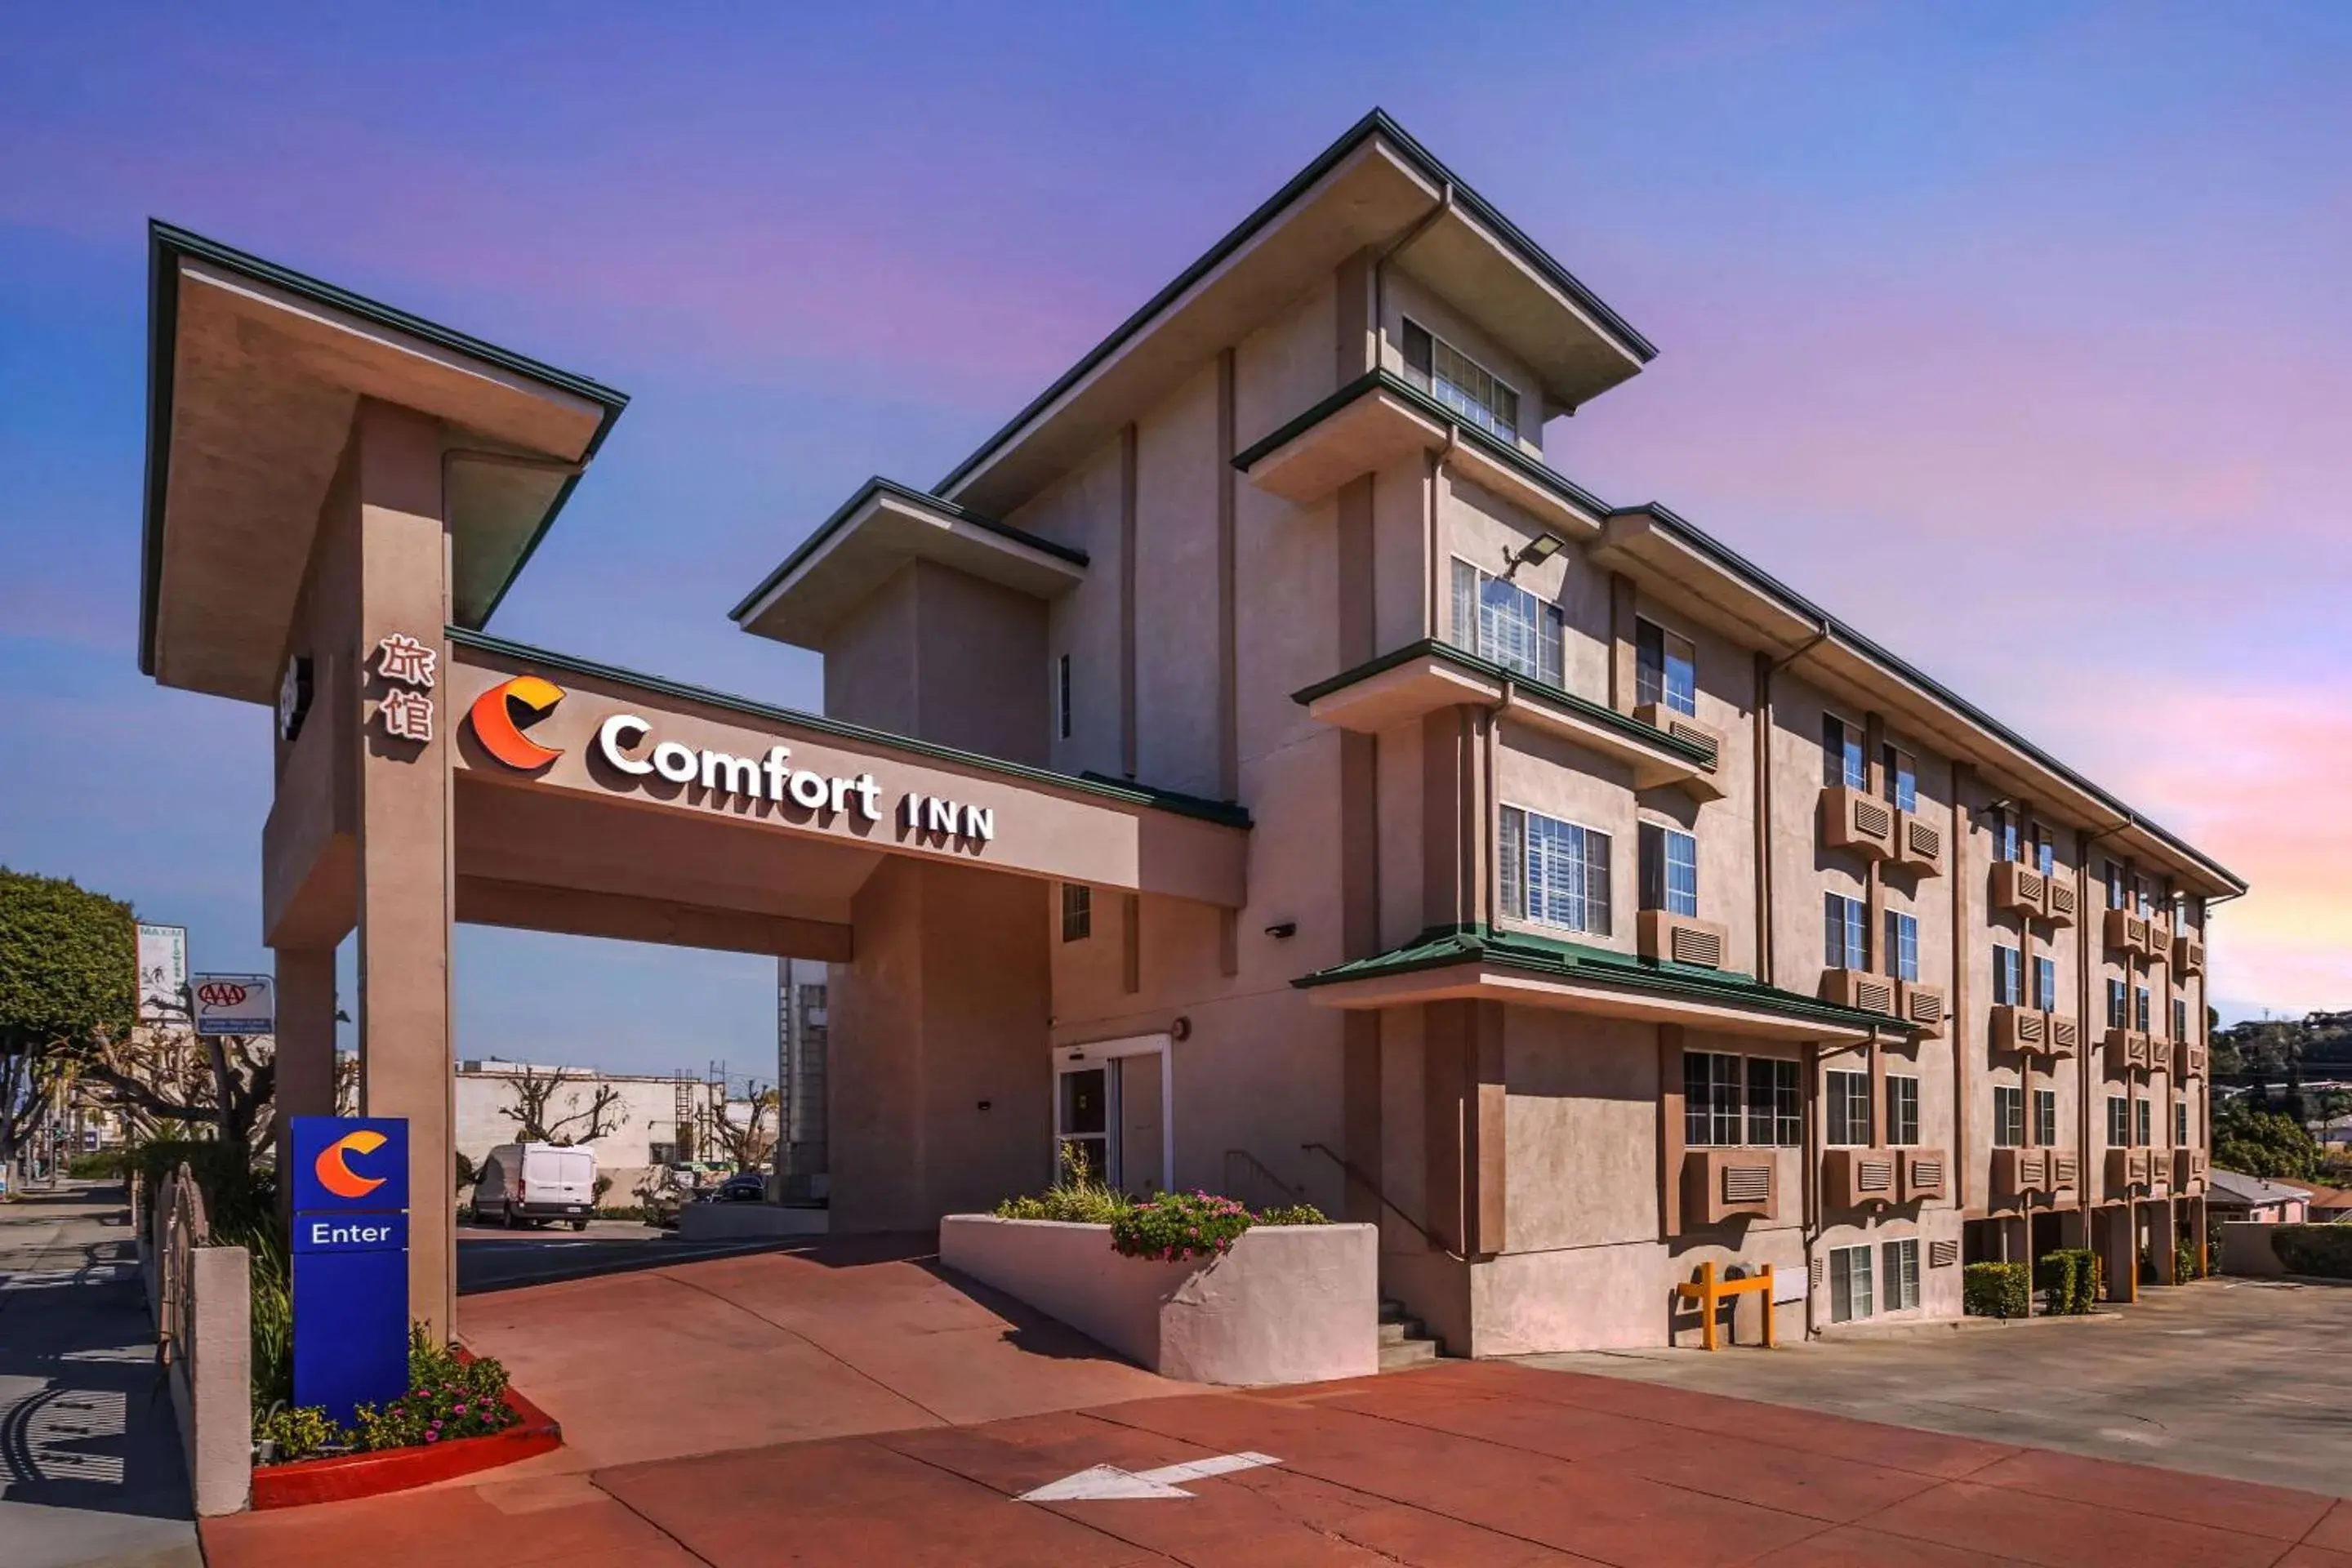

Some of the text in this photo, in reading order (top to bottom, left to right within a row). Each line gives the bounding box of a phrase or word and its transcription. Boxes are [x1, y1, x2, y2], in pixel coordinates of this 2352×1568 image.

[600, 713, 995, 841] Comfort INN
[201, 982, 245, 1006] AAA
[312, 1223, 392, 1245] Enter
